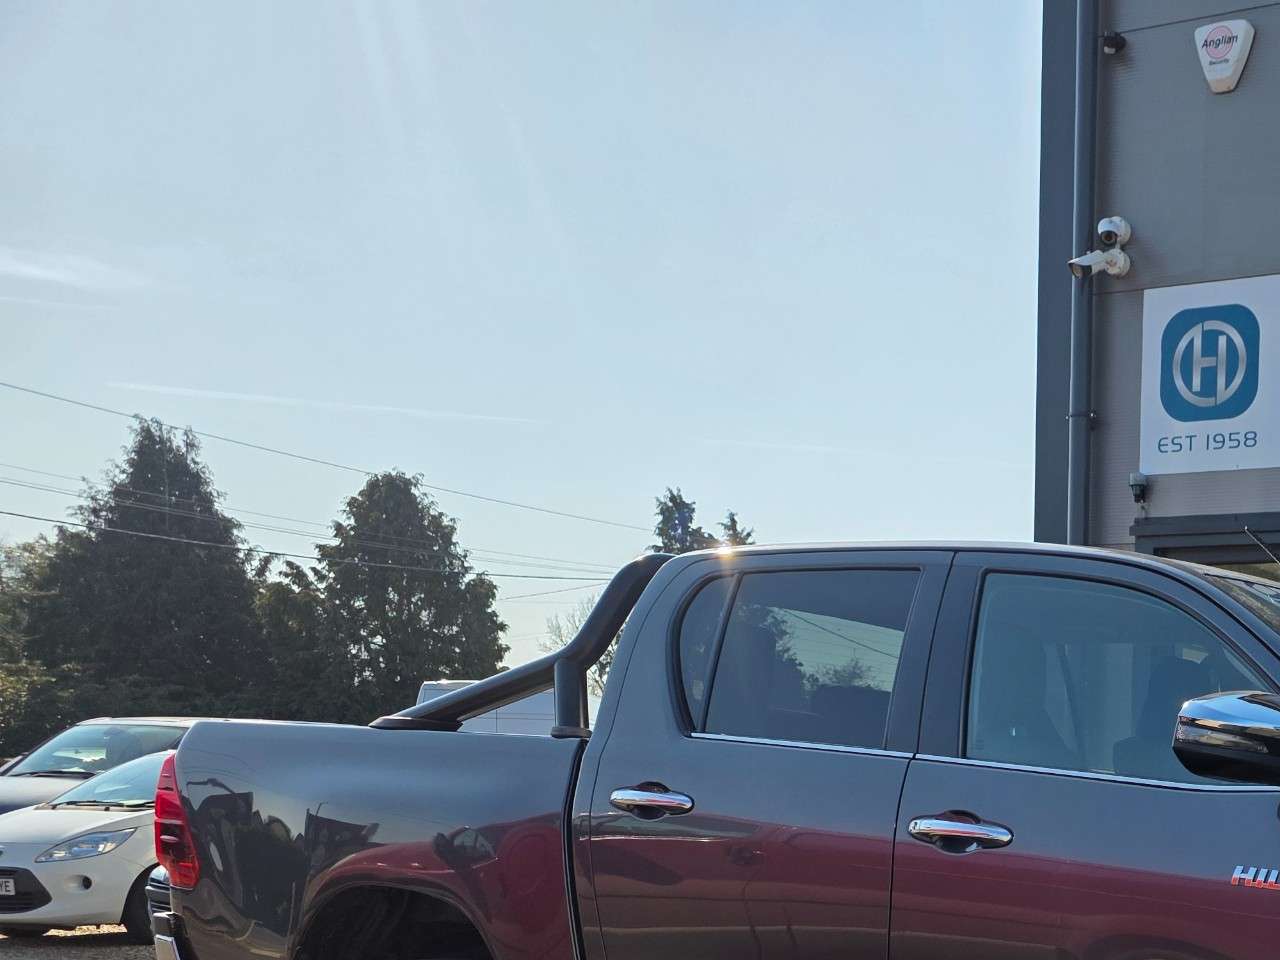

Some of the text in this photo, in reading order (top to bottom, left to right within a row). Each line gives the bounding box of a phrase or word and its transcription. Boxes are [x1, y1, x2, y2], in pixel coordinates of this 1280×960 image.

[1202, 34, 1239, 49] Anglian
[1158, 430, 1258, 454] EST 1958
